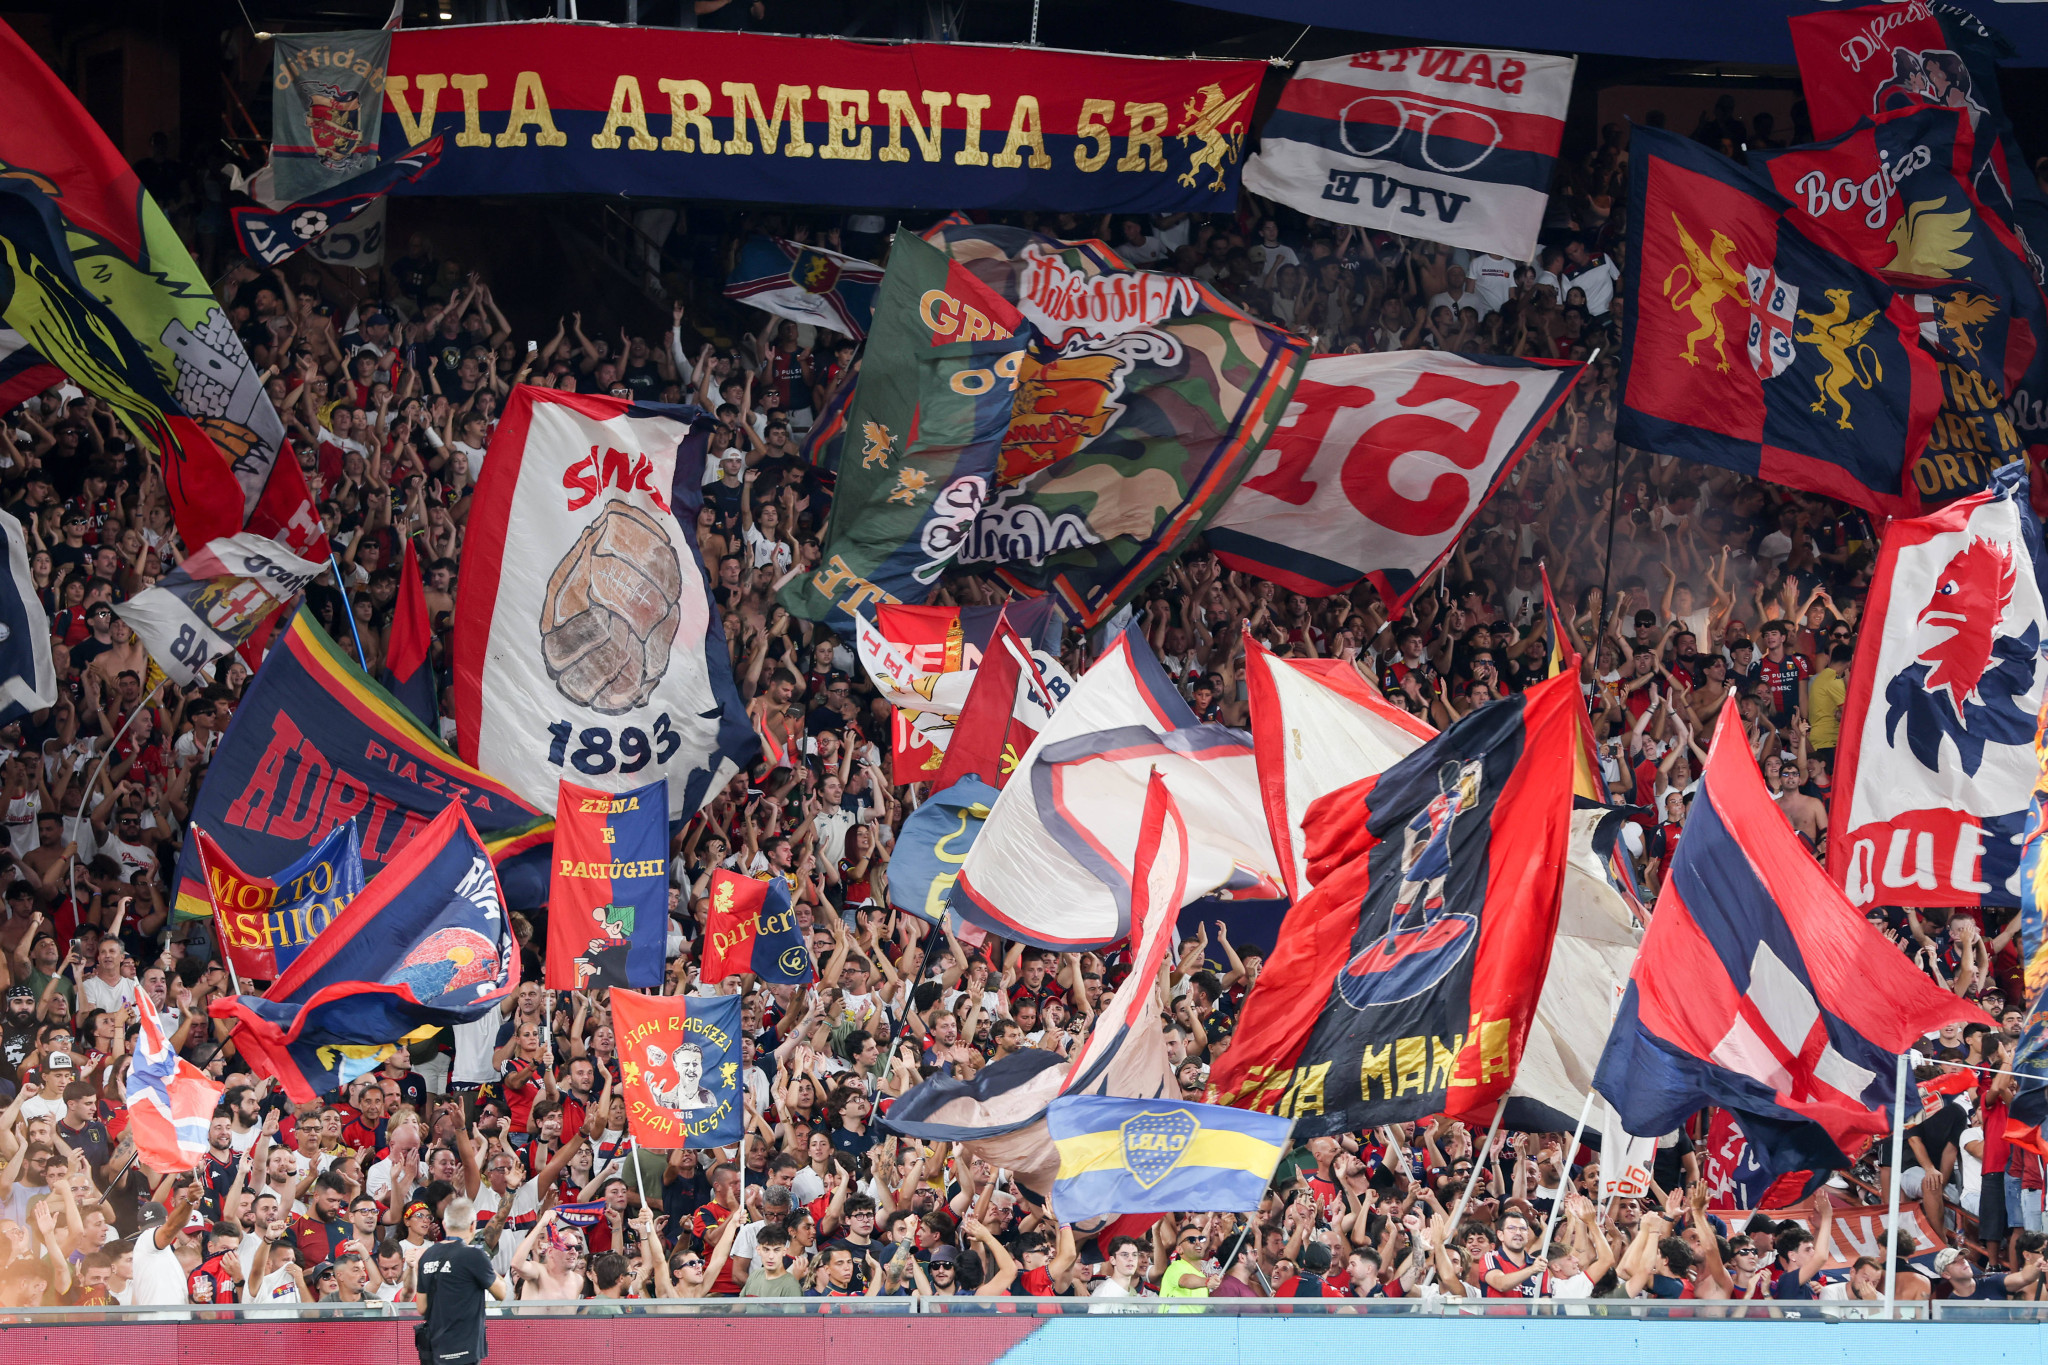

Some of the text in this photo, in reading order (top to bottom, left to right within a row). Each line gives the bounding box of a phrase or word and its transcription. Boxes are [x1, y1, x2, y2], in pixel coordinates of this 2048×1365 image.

[384, 71, 1168, 172] VIA ARMENIA 5R
[1795, 145, 1930, 229] Bogias
[1771, 671, 1798, 679] PULSEE
[547, 712, 681, 775] 1893
[365, 739, 492, 812] PIAZZA
[579, 796, 640, 815] ZÊNA
[211, 861, 333, 910] MOLTO
[559, 858, 665, 880] PACIÛGHI
[668, 1017, 733, 1052] RAGAZZI
[631, 1101, 673, 1134] SIAM
